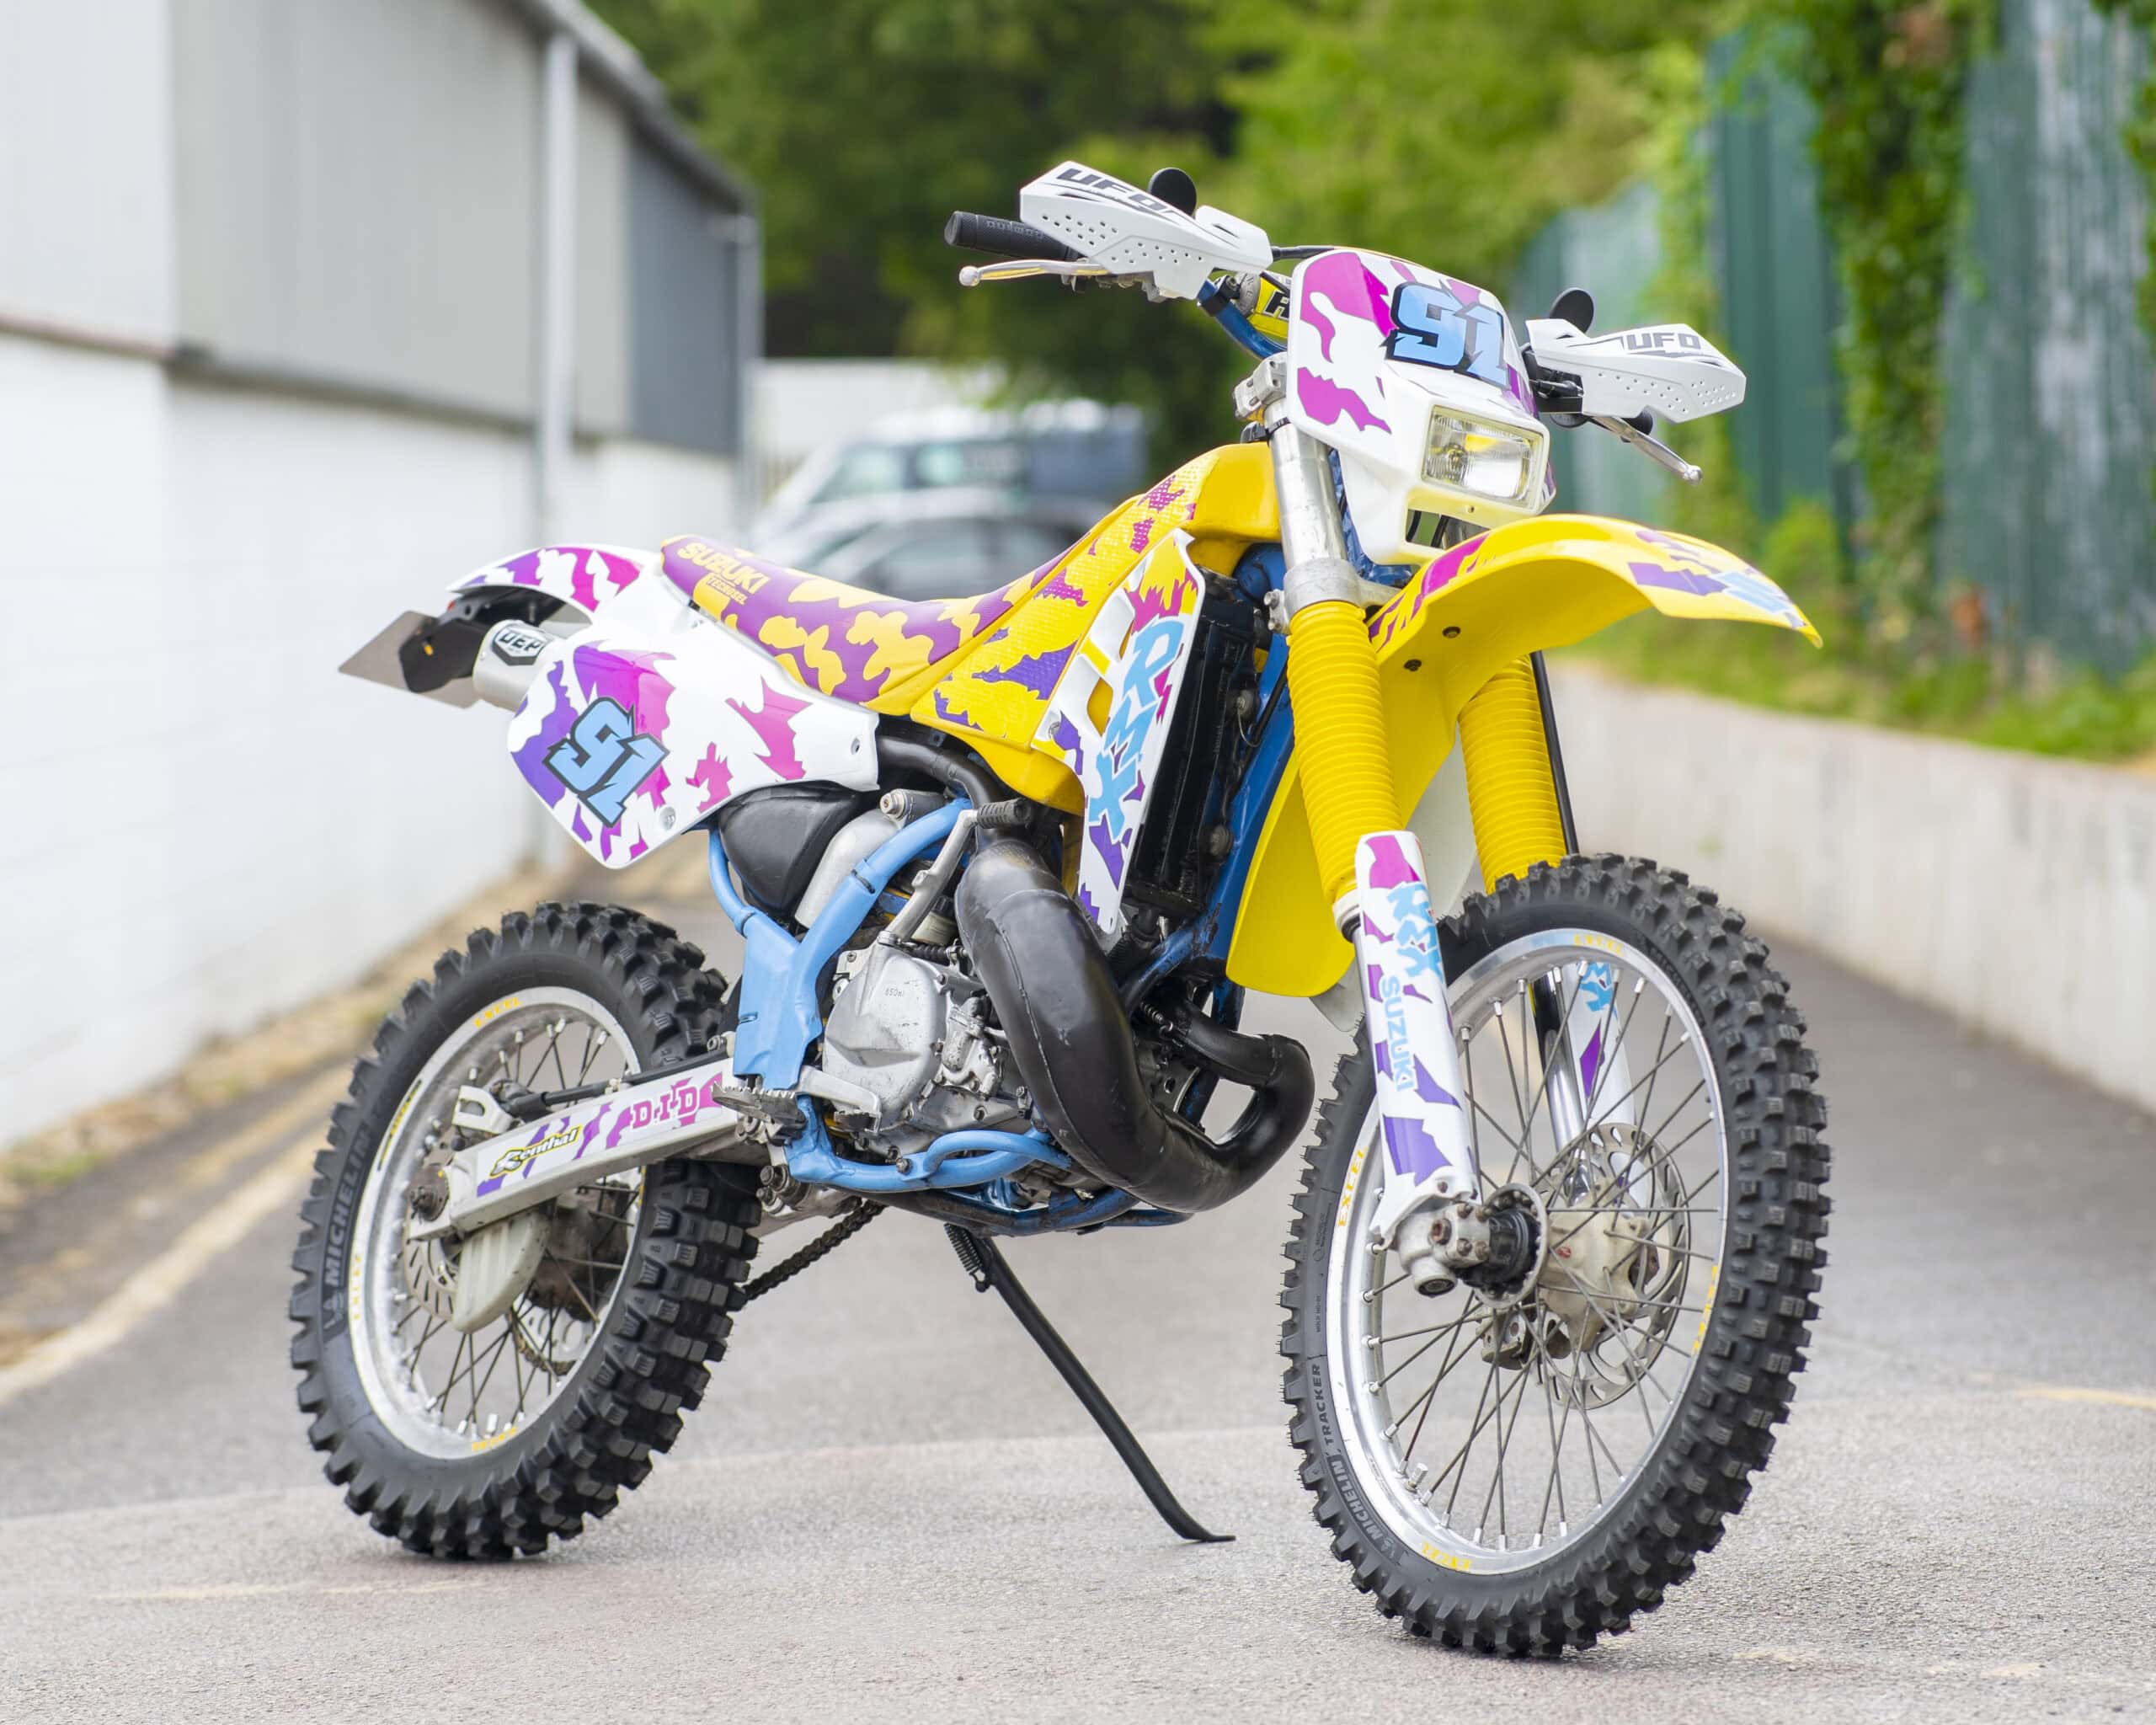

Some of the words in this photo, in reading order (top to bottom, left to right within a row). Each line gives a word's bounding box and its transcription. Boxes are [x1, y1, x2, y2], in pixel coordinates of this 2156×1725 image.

[1056, 168, 1168, 211] UFO
[1625, 332, 1701, 350] UFO
[677, 542, 771, 595] SUZUKI
[499, 630, 545, 651] DEP
[1381, 975, 1414, 1092] SUZUKI
[489, 1126, 581, 1177] Renthal
[324, 1124, 371, 1287] MICHELIN
[1311, 1364, 1335, 1447] TRACKER
[1331, 1459, 1384, 1542] MICHELIN
